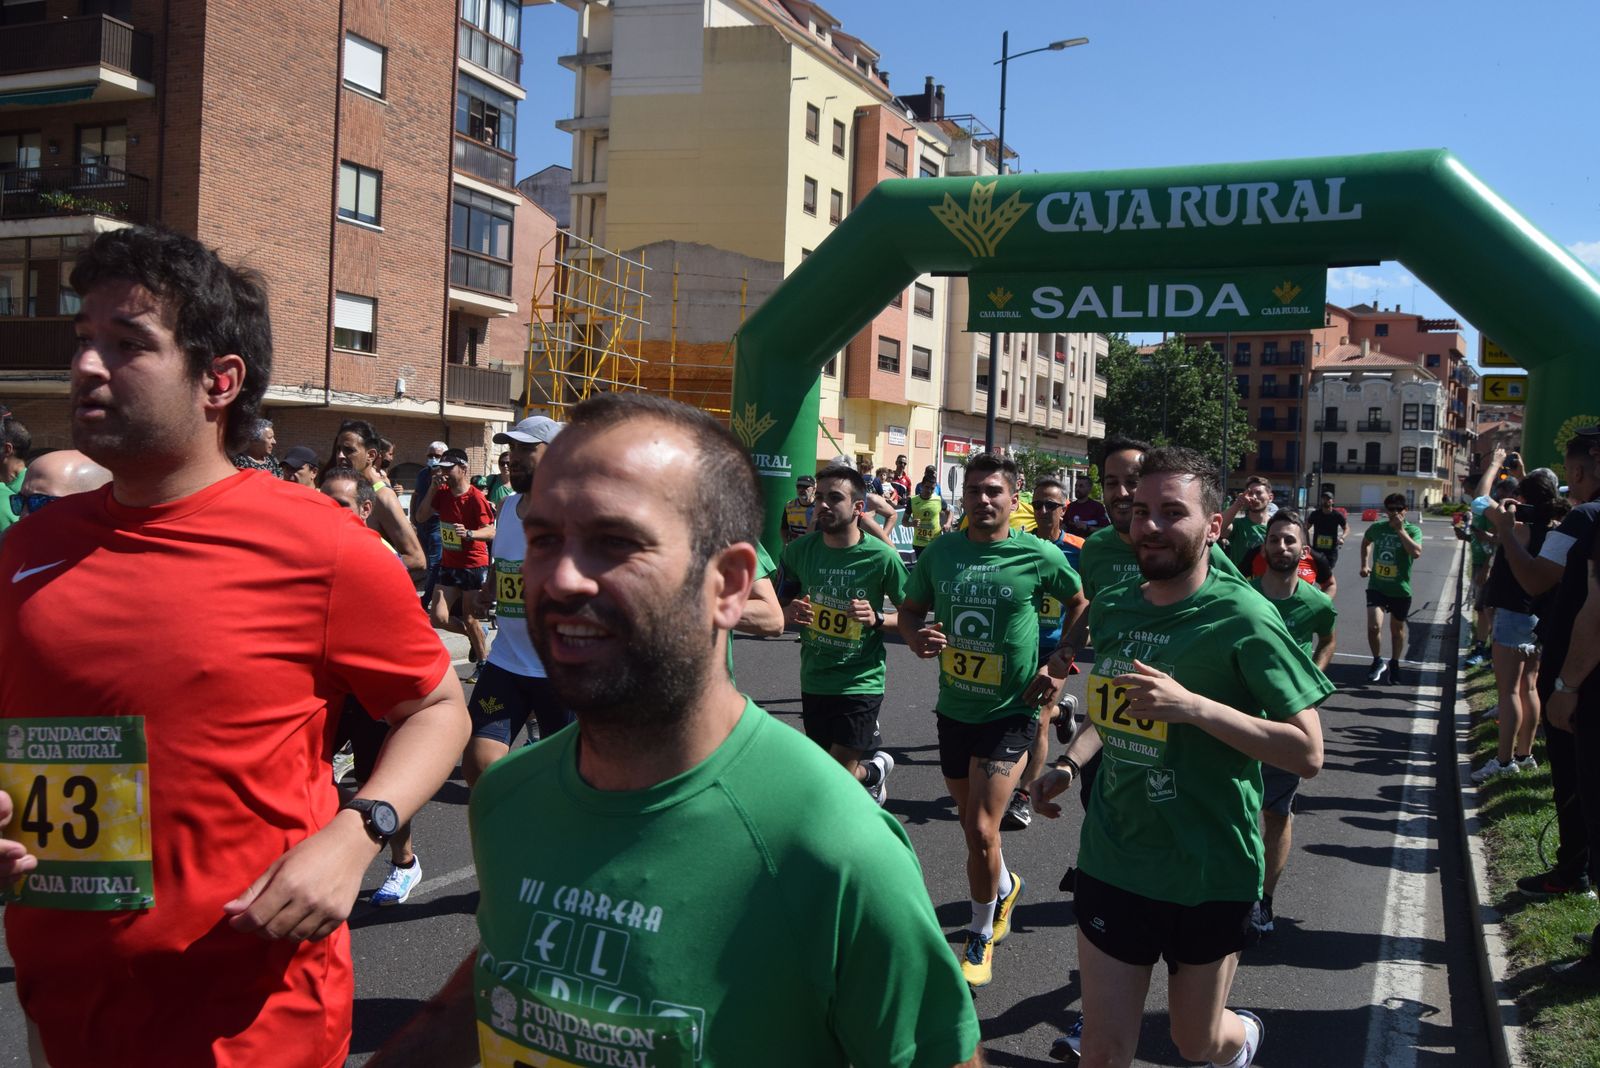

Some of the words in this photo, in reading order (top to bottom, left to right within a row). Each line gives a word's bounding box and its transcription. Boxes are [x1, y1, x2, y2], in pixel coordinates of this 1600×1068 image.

[1036, 188, 1162, 234] CAJA
[1166, 176, 1363, 229] RURAL
[1030, 282, 1251, 319] SALIDA
[979, 310, 996, 318] CAJA
[996, 310, 1021, 318] RURAL
[1260, 307, 1280, 316] CAJA
[1281, 306, 1311, 315] RURAL
[751, 453, 792, 469] URAL
[1378, 565, 1391, 576] 79
[951, 595, 961, 603] DE
[965, 596, 997, 606] ZAMORA
[818, 609, 848, 634] 69
[1128, 630, 1171, 645] CARRERA
[953, 652, 986, 679] 37
[954, 681, 971, 691] CAJA
[971, 685, 997, 696] RURAL
[27, 726, 123, 743] FUNDACION
[27, 743, 65, 760] CAJA
[67, 743, 123, 759] RURAL
[1107, 735, 1127, 750] CAJA
[1128, 740, 1159, 758] RURAL
[21, 774, 100, 850] 43
[28, 874, 66, 893] CAJA
[70, 876, 141, 894] RURAL
[519, 877, 545, 904] VII
[552, 885, 664, 933] CARRERA
[521, 998, 656, 1050] FUNDACION
[522, 1022, 569, 1056] CAJA
[574, 1040, 656, 1068] RURAL
